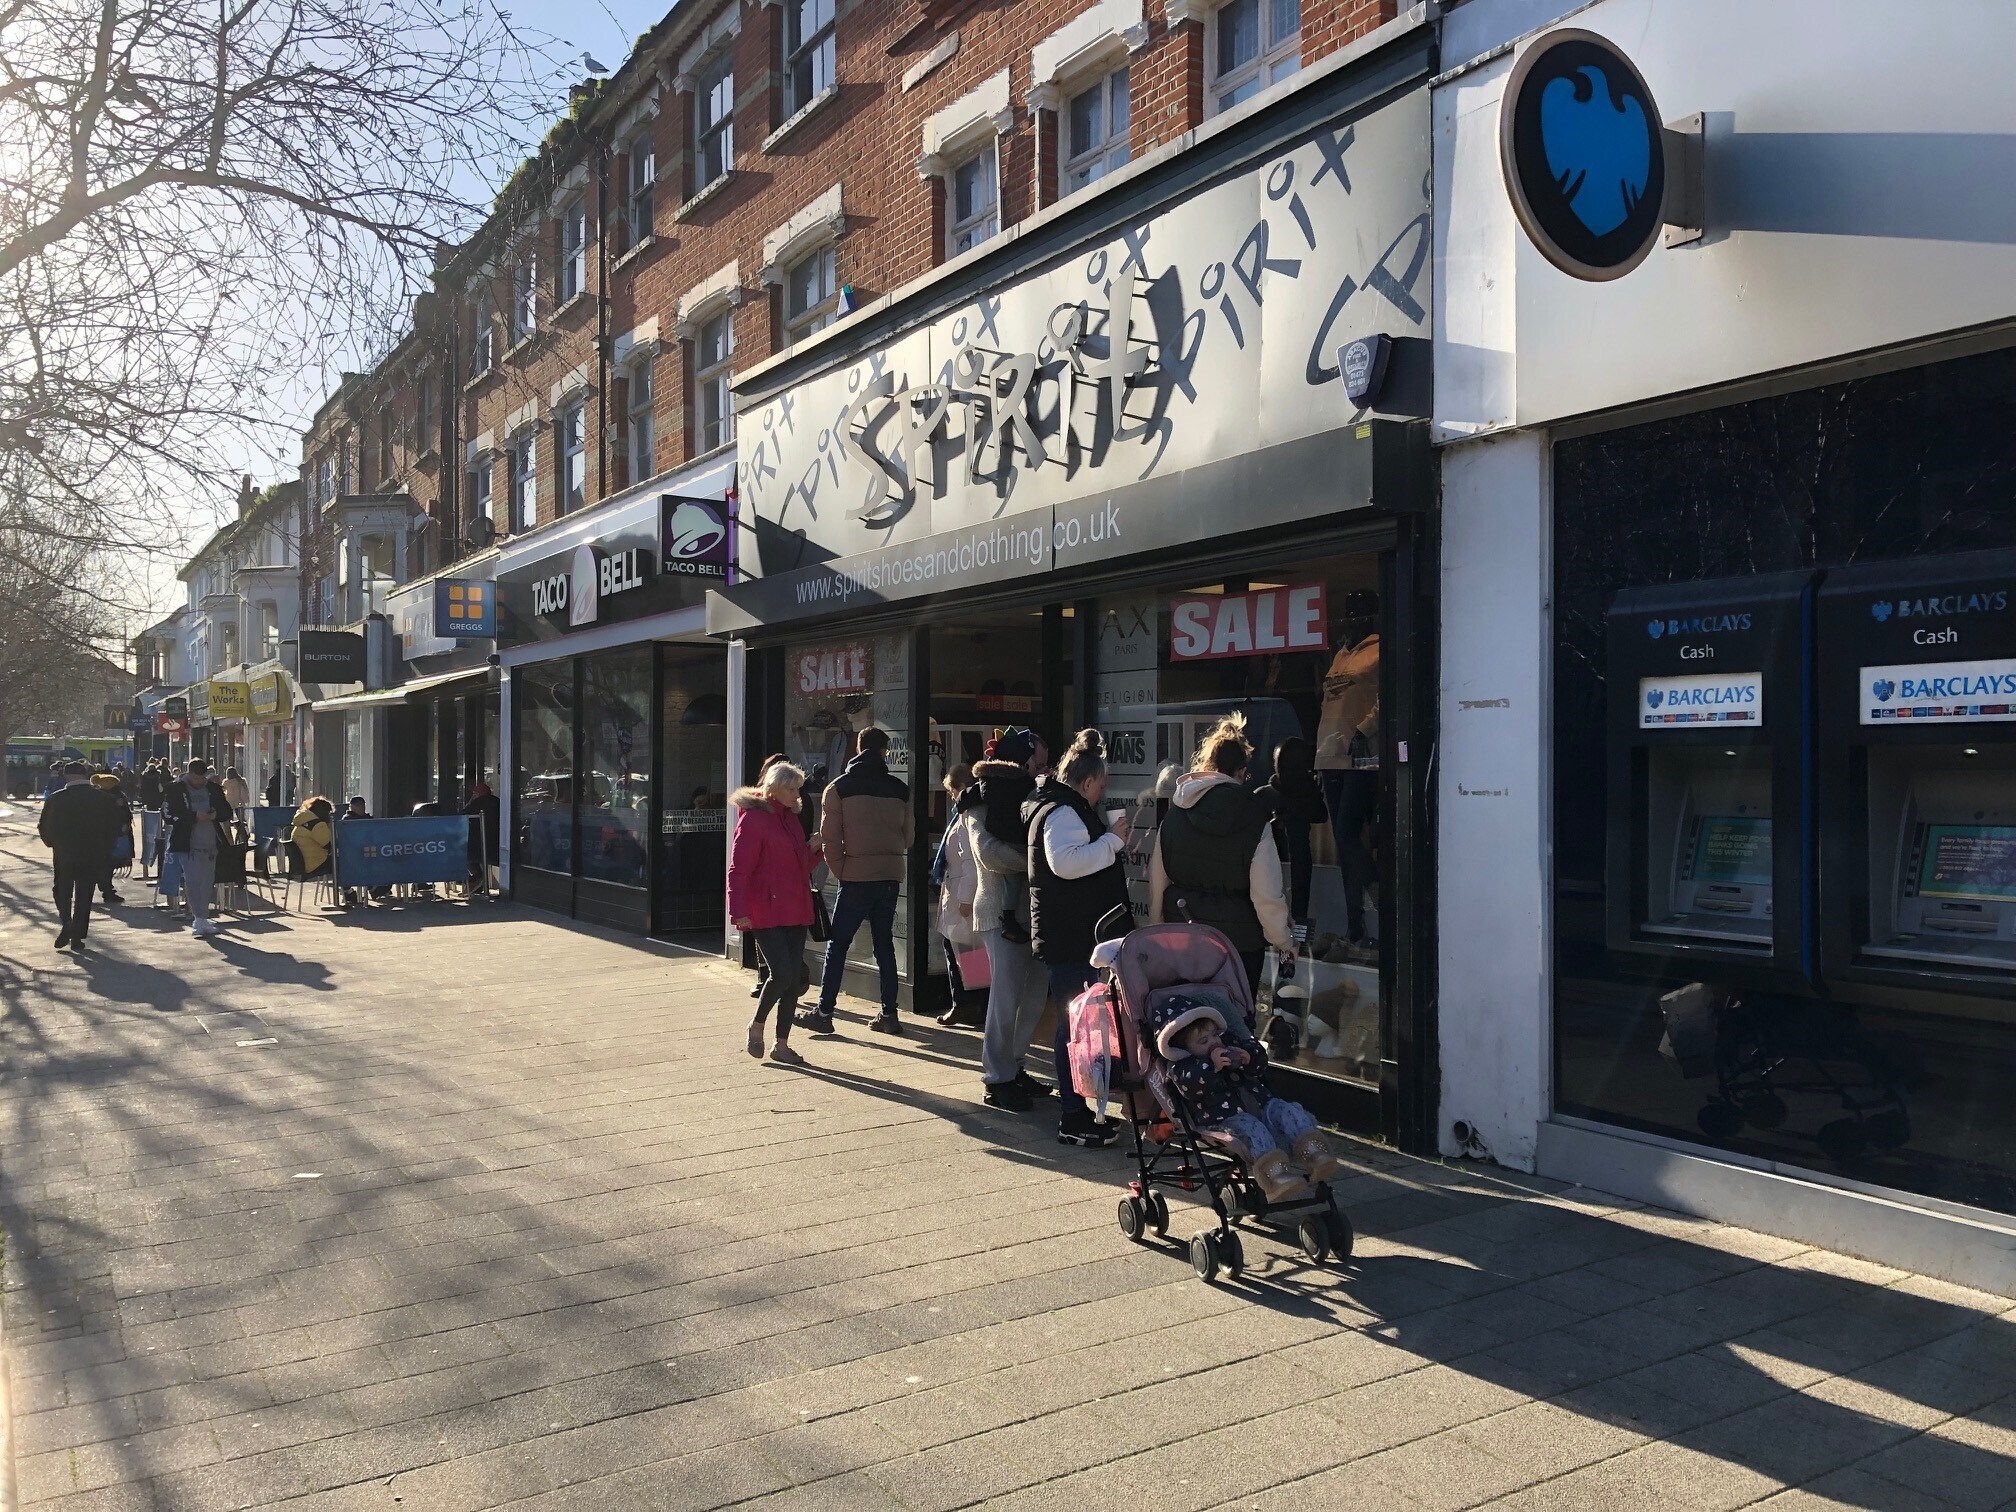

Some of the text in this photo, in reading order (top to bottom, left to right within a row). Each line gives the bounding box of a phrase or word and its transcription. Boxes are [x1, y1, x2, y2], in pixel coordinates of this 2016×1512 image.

[795, 499, 1121, 603] www.spiritshoesandclothing.co.uk
[665, 561, 725, 576] TACO BELL
[532, 548, 642, 617] TACO BELL
[1898, 591, 2007, 617] BARCLAYS
[449, 622, 483, 631] GREGGS
[1099, 606, 1151, 639] AX
[1172, 586, 1323, 657] SALE
[1667, 613, 1752, 635] BARCLAYS
[1913, 628, 1958, 646] Cash
[304, 652, 350, 663] BURTON
[1114, 644, 1138, 656] PARIS
[1680, 644, 1714, 660] Cash
[801, 649, 867, 692] SALE
[219, 686, 239, 695] The
[1668, 685, 1756, 706] BARCLAYS
[1901, 674, 2016, 699] BARCLAYS
[212, 695, 245, 704] Works
[1104, 730, 1146, 765] VANS
[380, 840, 446, 857] GREGGS
[1119, 850, 1151, 869] erdry
